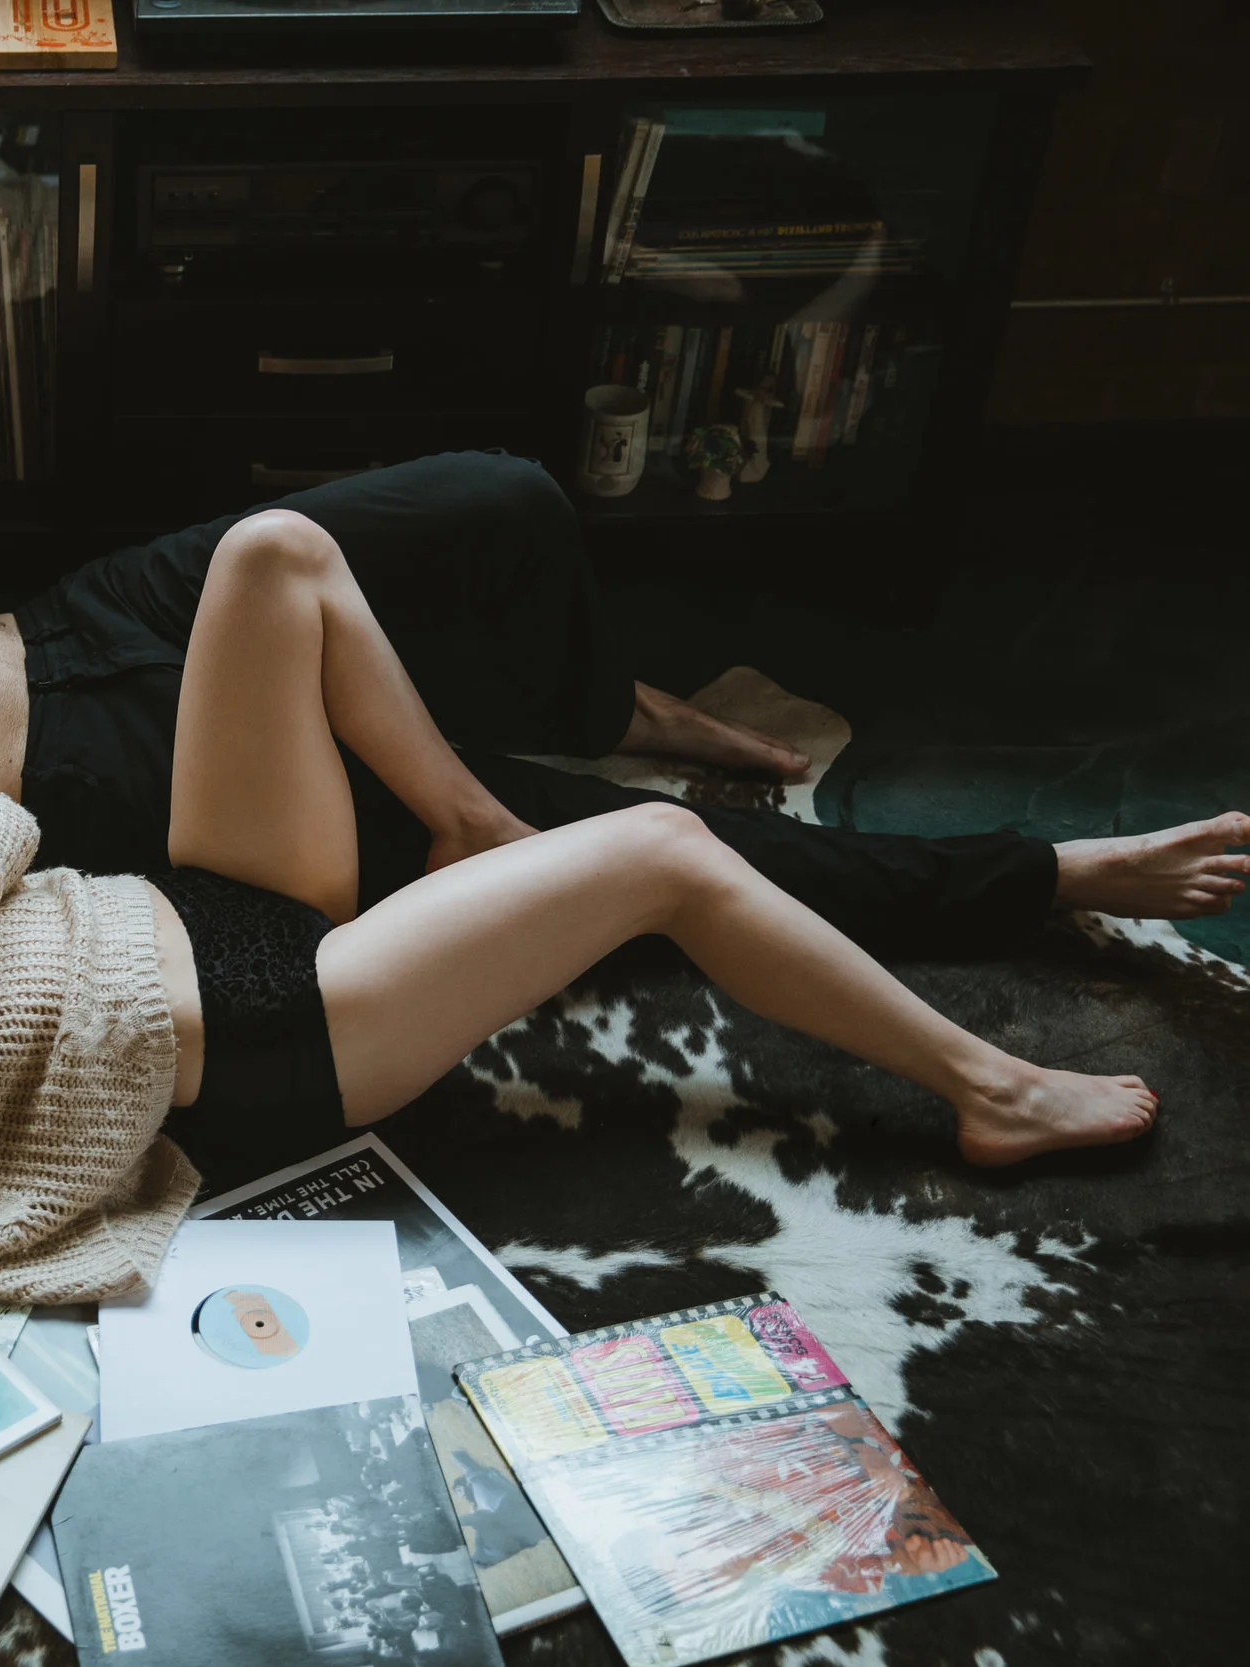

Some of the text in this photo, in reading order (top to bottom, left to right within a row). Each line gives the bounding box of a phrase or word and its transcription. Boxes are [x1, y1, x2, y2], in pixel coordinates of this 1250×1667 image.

[296, 1178, 330, 1198] THE
[352, 1171, 385, 1193] IN
[298, 1187, 353, 1217] THE
[671, 1343, 753, 1400] BLUE
[789, 1356, 827, 1384] 14
[581, 1344, 686, 1430] ELVIS
[104, 1564, 147, 1652] BOXER
